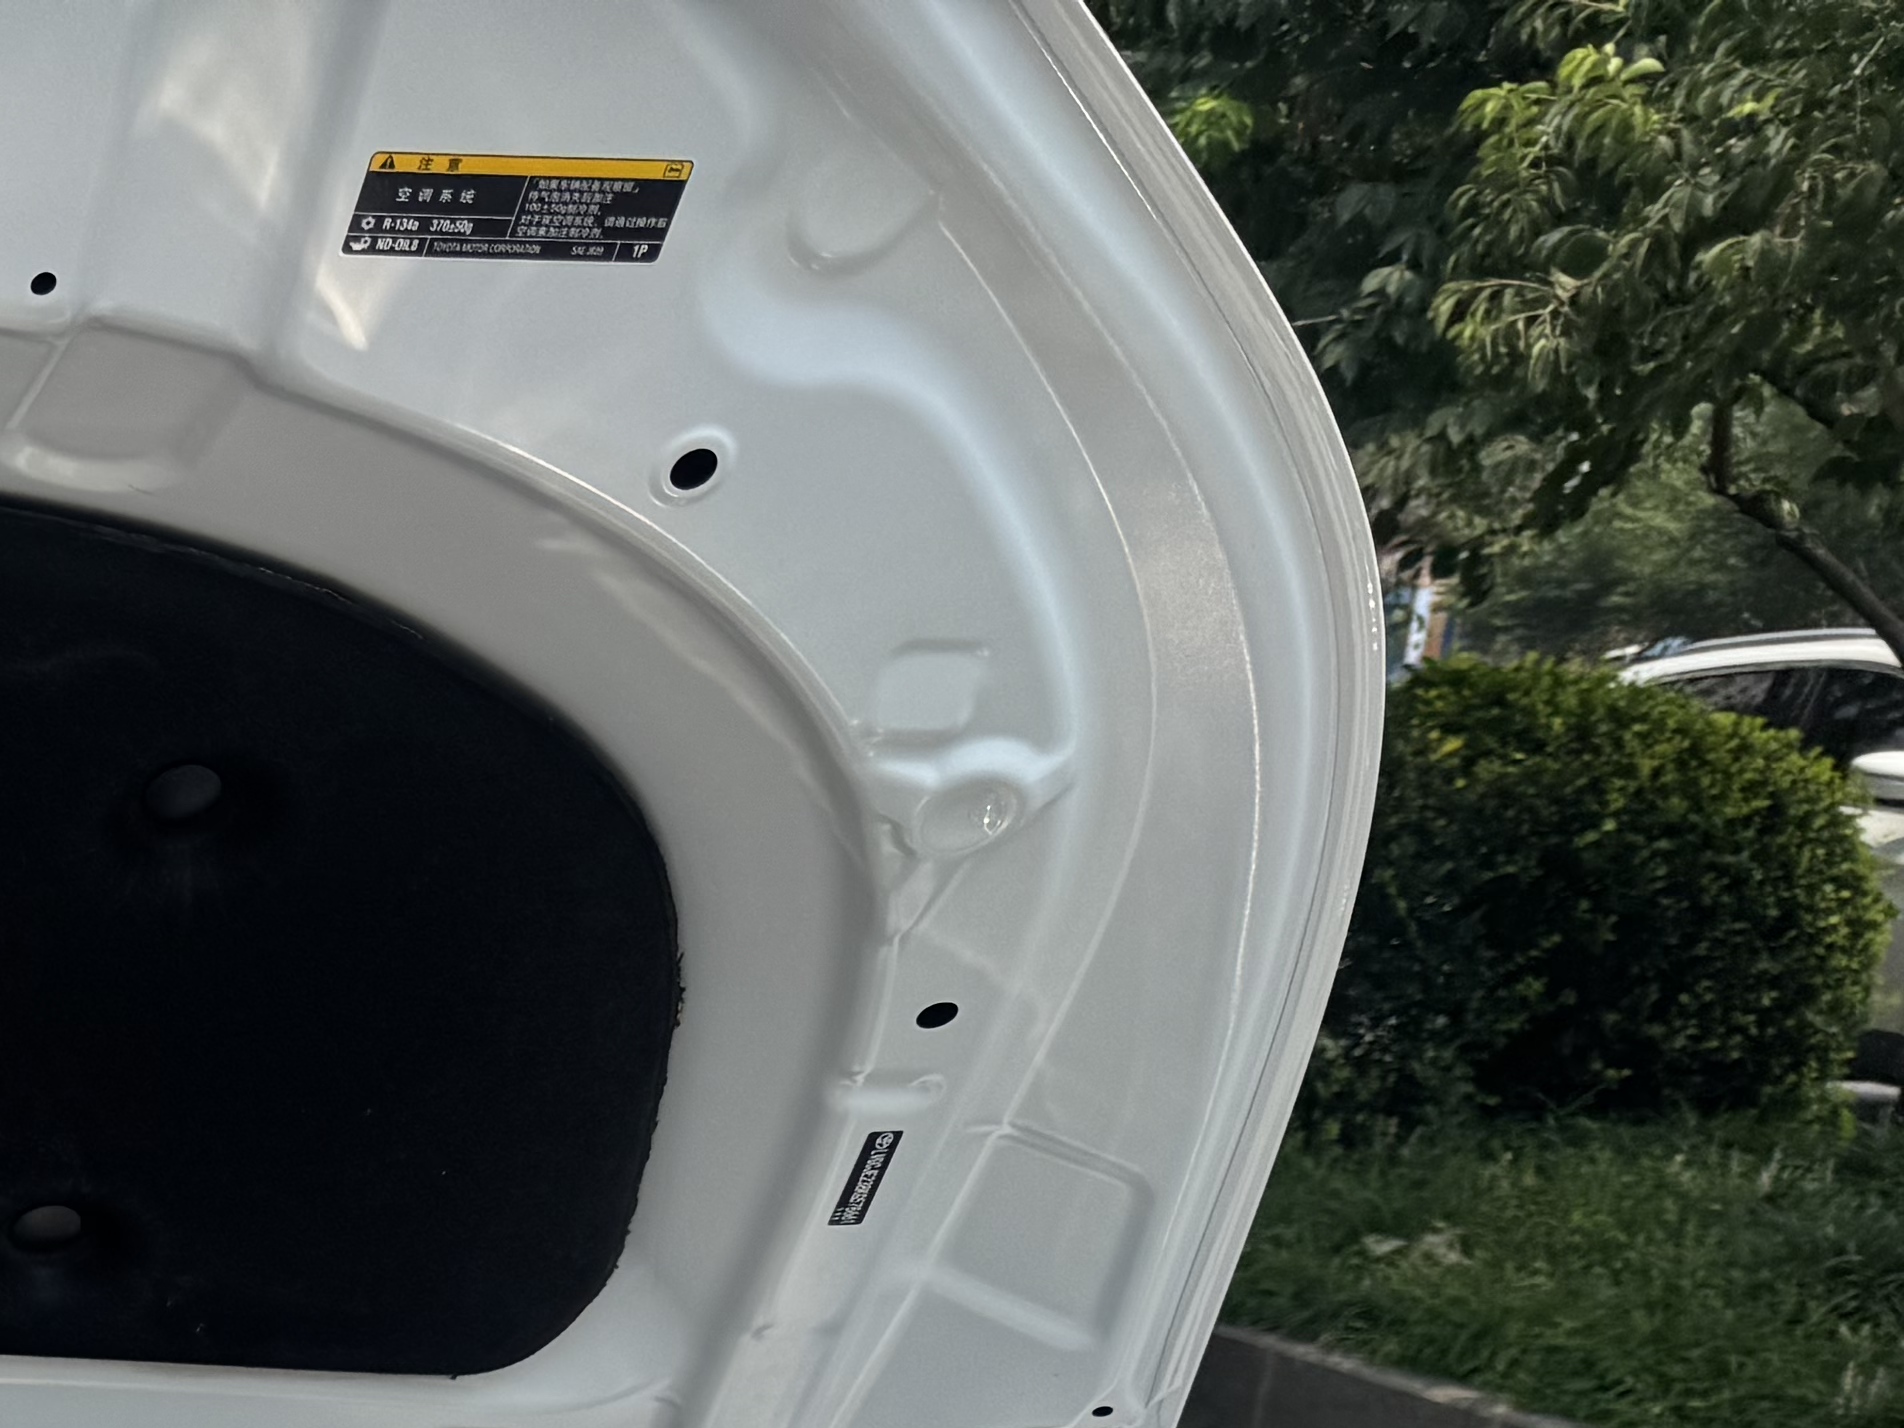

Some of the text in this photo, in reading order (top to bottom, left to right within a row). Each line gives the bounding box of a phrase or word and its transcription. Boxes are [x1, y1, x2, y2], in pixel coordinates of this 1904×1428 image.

[417, 157, 463, 172] 注意
[395, 187, 477, 204] 空调系统
[382, 217, 474, 236] R-134a 370±50g
[632, 244, 650, 258] 1P
